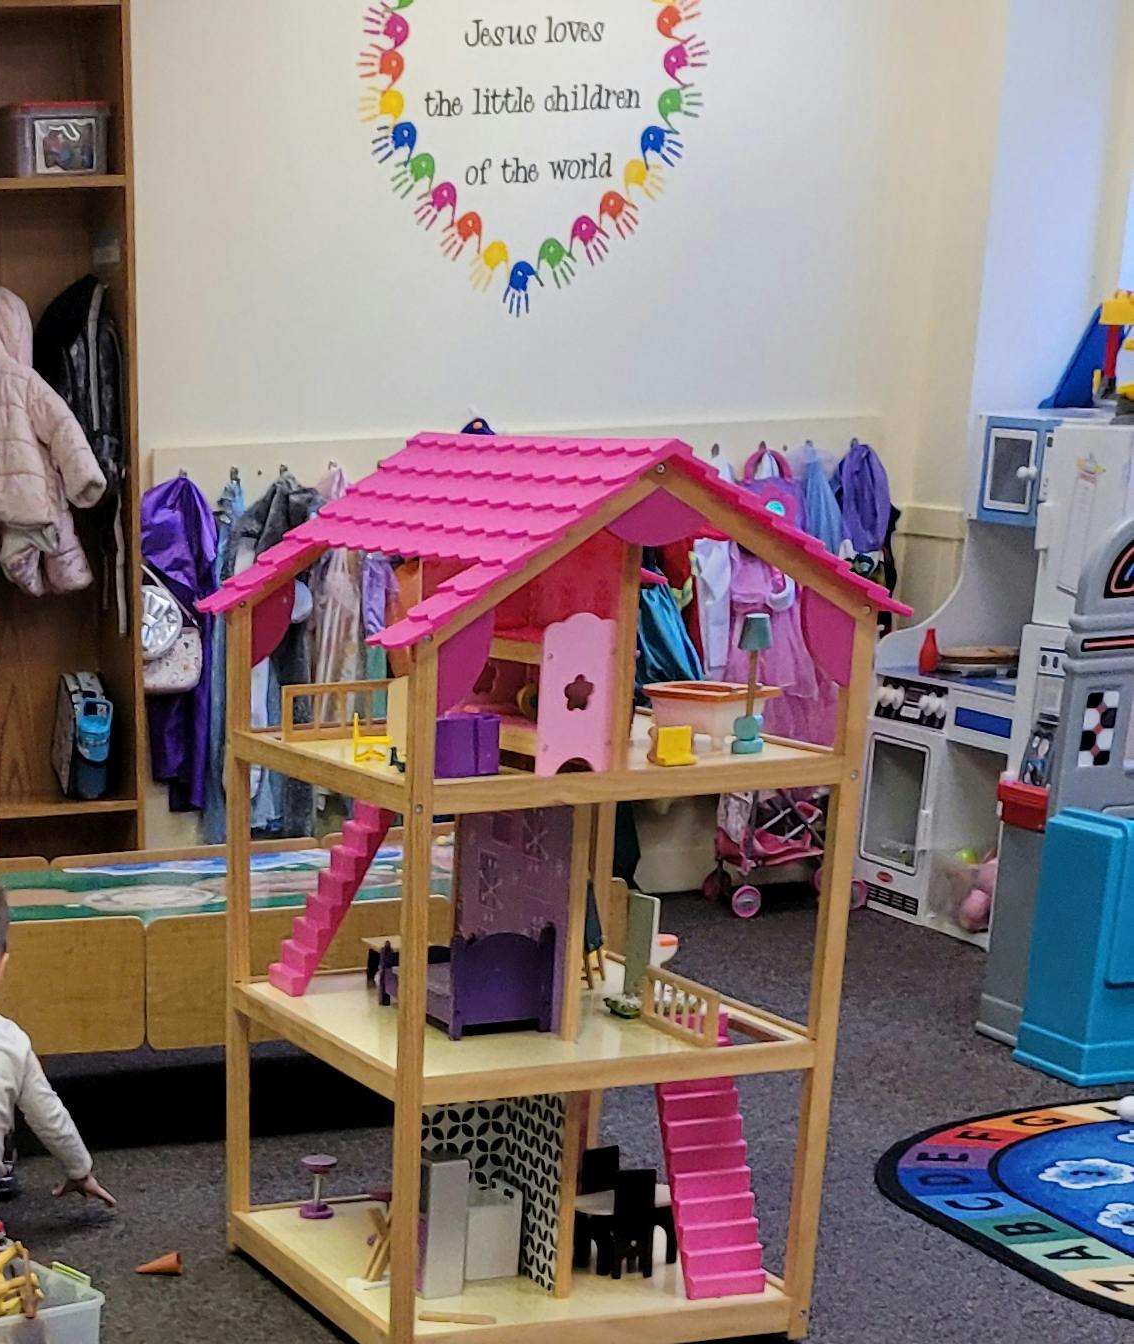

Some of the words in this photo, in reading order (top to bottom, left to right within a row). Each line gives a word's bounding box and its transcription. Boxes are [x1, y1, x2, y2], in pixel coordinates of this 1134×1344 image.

[464, 18, 537, 48] Jesus
[545, 16, 605, 44] loves
[424, 90, 464, 118] the
[471, 87, 535, 116] little
[543, 84, 641, 113] children
[464, 158, 493, 186] of
[501, 157, 539, 184] the
[548, 152, 613, 181] world
[1011, 1115, 1067, 1127] G
[954, 1130, 1003, 1142] F
[917, 1152, 969, 1162] E
[919, 1173, 973, 1186] D
[944, 1196, 1004, 1211] C
[993, 1221, 1058, 1237] B
[1043, 1245, 1111, 1260] A
